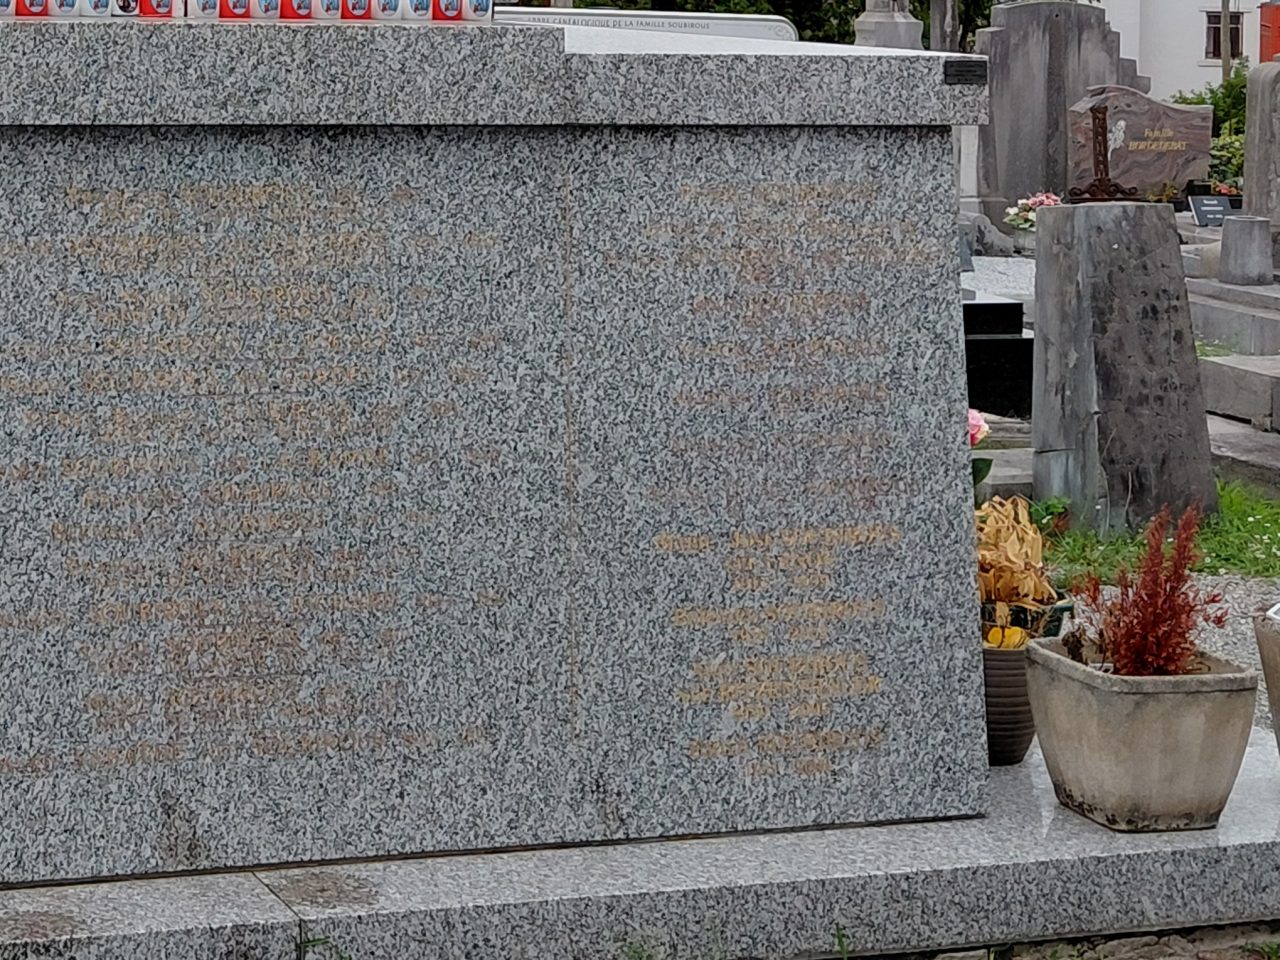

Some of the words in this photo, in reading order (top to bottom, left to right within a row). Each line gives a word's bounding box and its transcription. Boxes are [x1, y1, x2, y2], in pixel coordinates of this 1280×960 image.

[624, 20, 634, 28] LA
[636, 20, 665, 29] FAMILLE
[667, 21, 710, 30] SOUBIROUS
